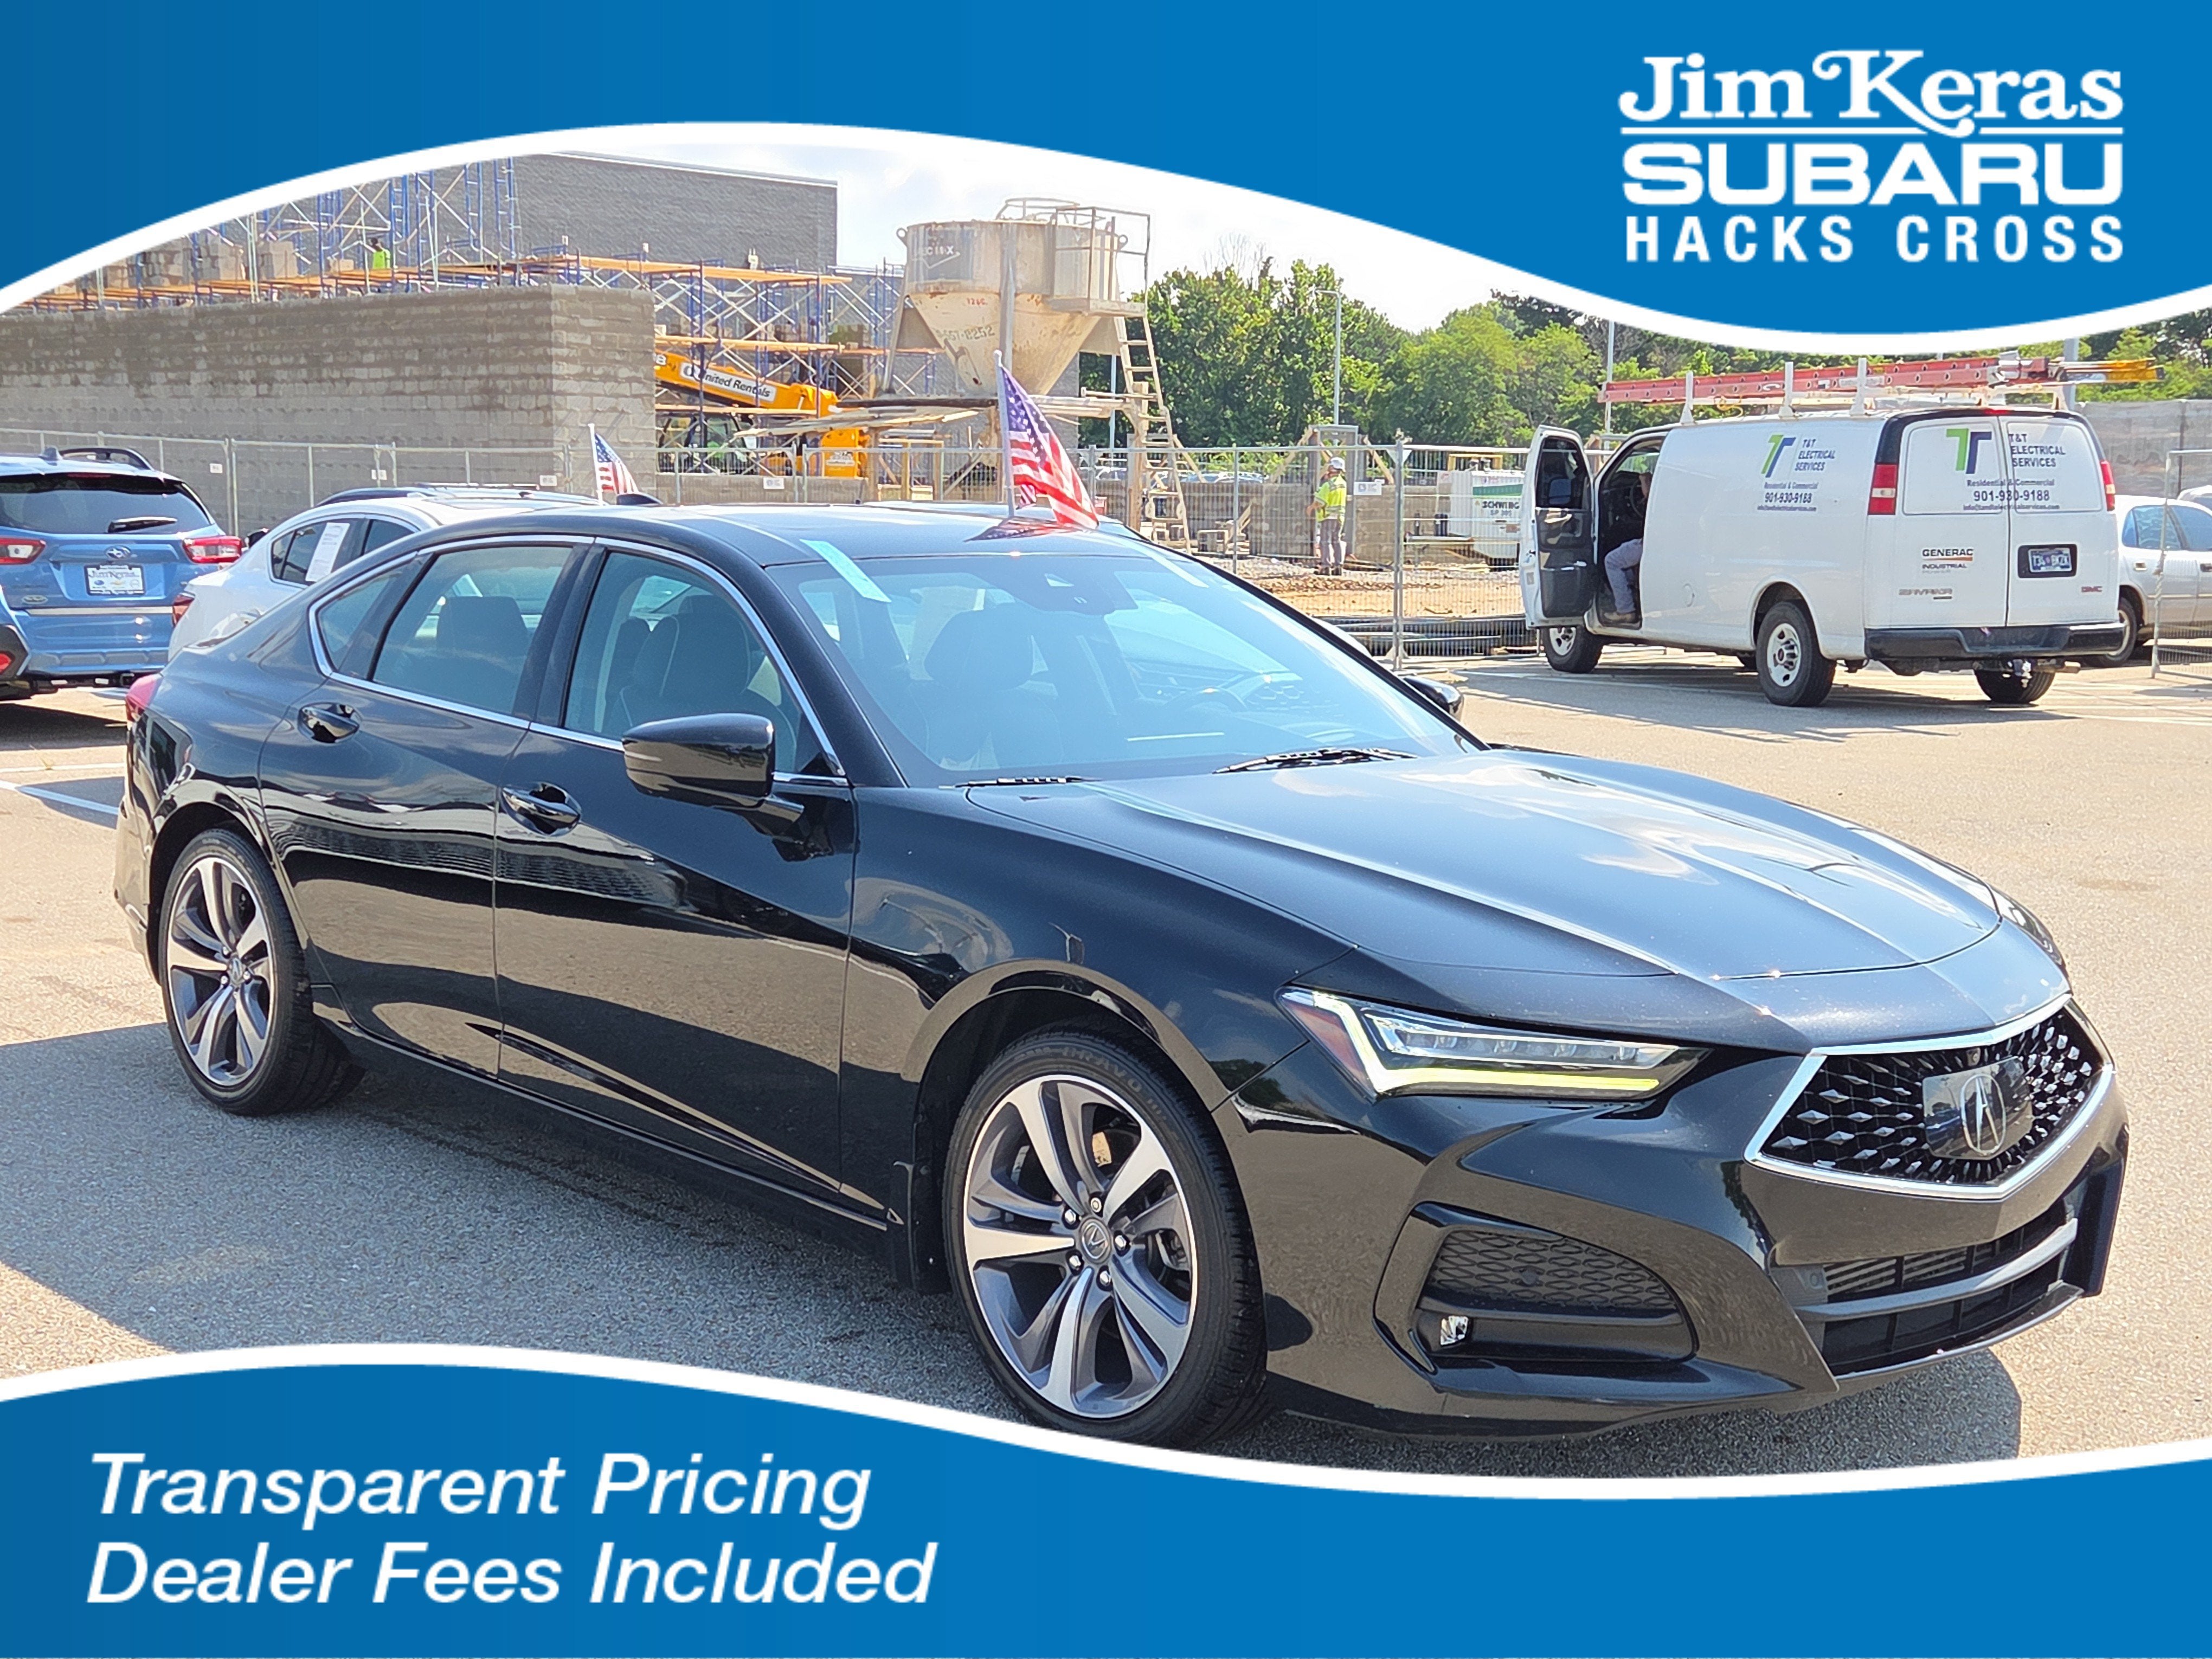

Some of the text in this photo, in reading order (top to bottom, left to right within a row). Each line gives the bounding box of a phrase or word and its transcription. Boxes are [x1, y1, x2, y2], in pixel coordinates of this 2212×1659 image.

[2008, 434, 2027, 442] T&T
[1798, 451, 1836, 459] ELECTRICAL
[2011, 446, 2066, 455] ELECTRICAL
[1795, 462, 1825, 471] SERVICES
[2012, 458, 2056, 467] SERVICES
[1973, 490, 2050, 501] 901-930-9188
